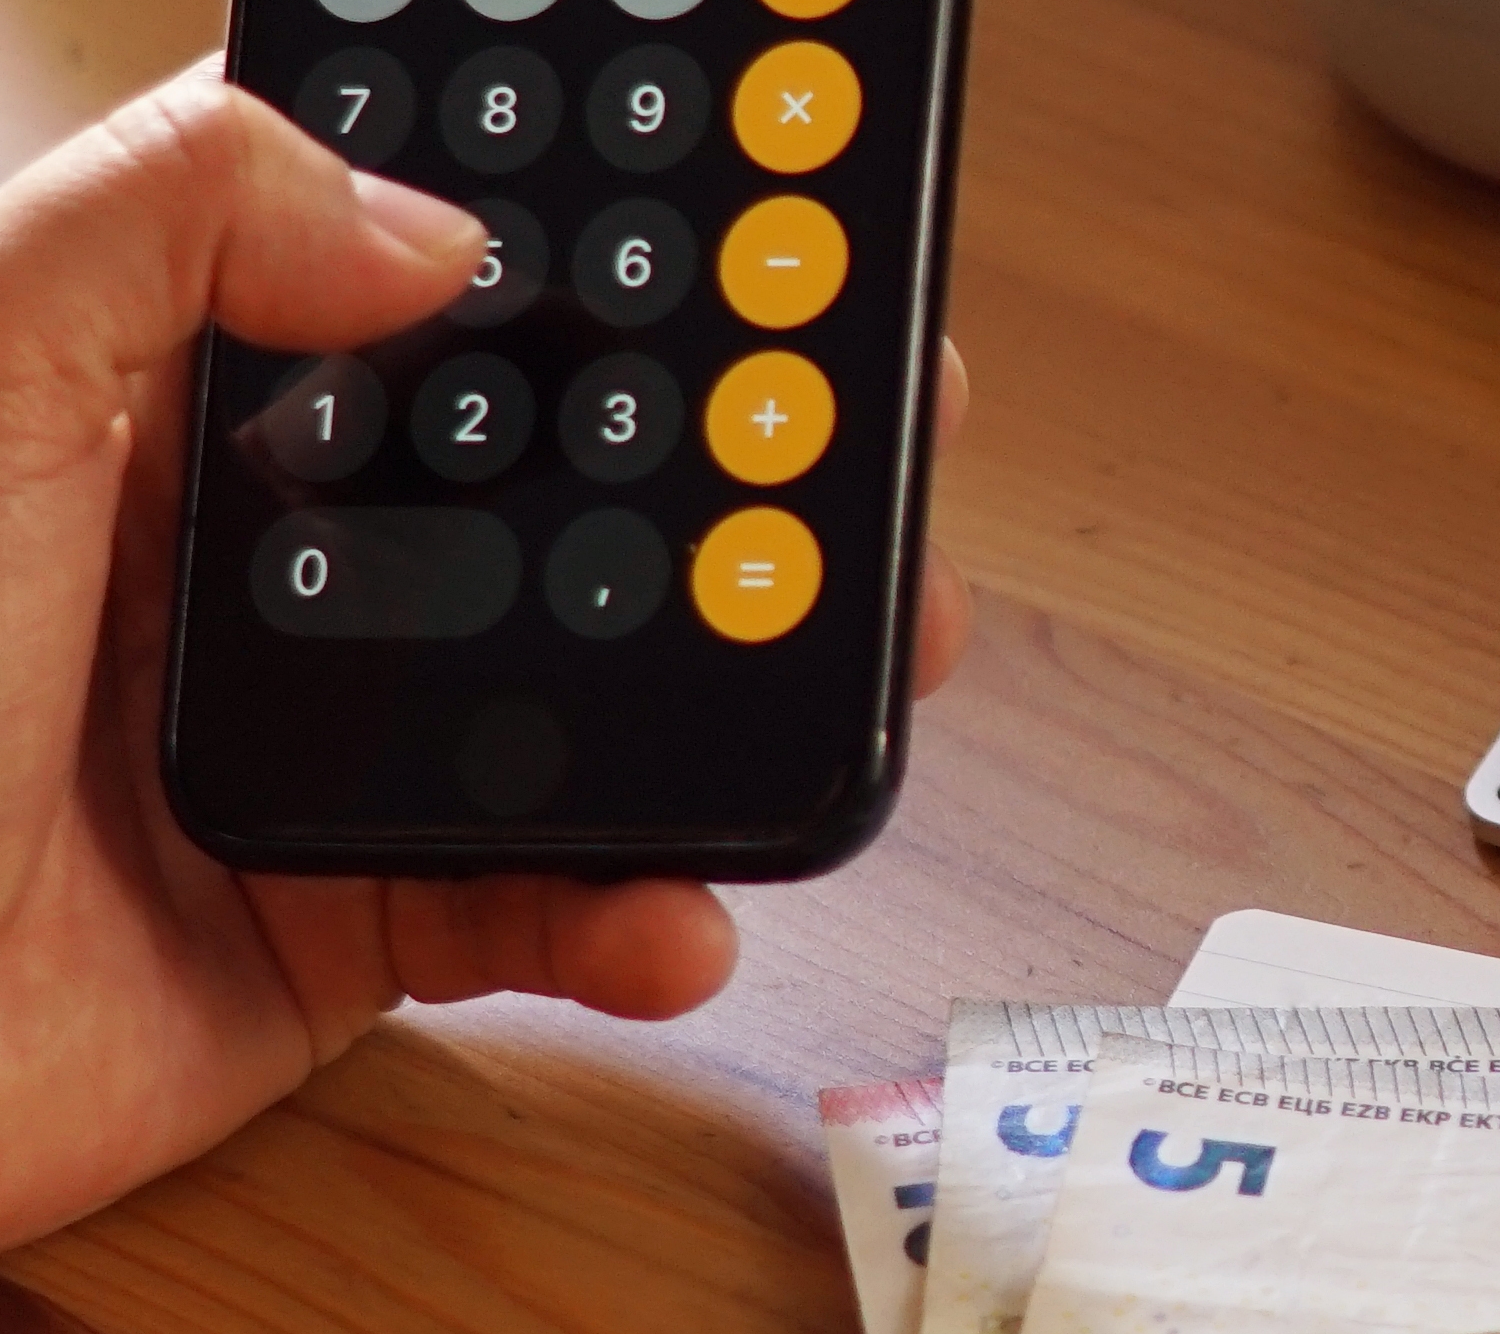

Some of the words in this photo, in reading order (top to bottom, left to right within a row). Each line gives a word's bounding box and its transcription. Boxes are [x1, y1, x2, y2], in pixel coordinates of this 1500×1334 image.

[339, 87, 371, 134] 7
[481, 85, 517, 134] 8
[629, 84, 666, 133] 9
[470, 240, 503, 288] 5
[615, 238, 652, 288] 6
[313, 394, 335, 441] 1
[454, 393, 489, 443] 2
[602, 393, 637, 443] 3
[751, 399, 788, 438] +
[291, 547, 328, 597] 0
[738, 562, 775, 588] =
[1066, 1058, 1095, 1074] EC
[1218, 1088, 1269, 1107] ECB
[1341, 1102, 1391, 1121] EZB
[1399, 1107, 1452, 1127] EKP
[1128, 1128, 1277, 1197] 5
